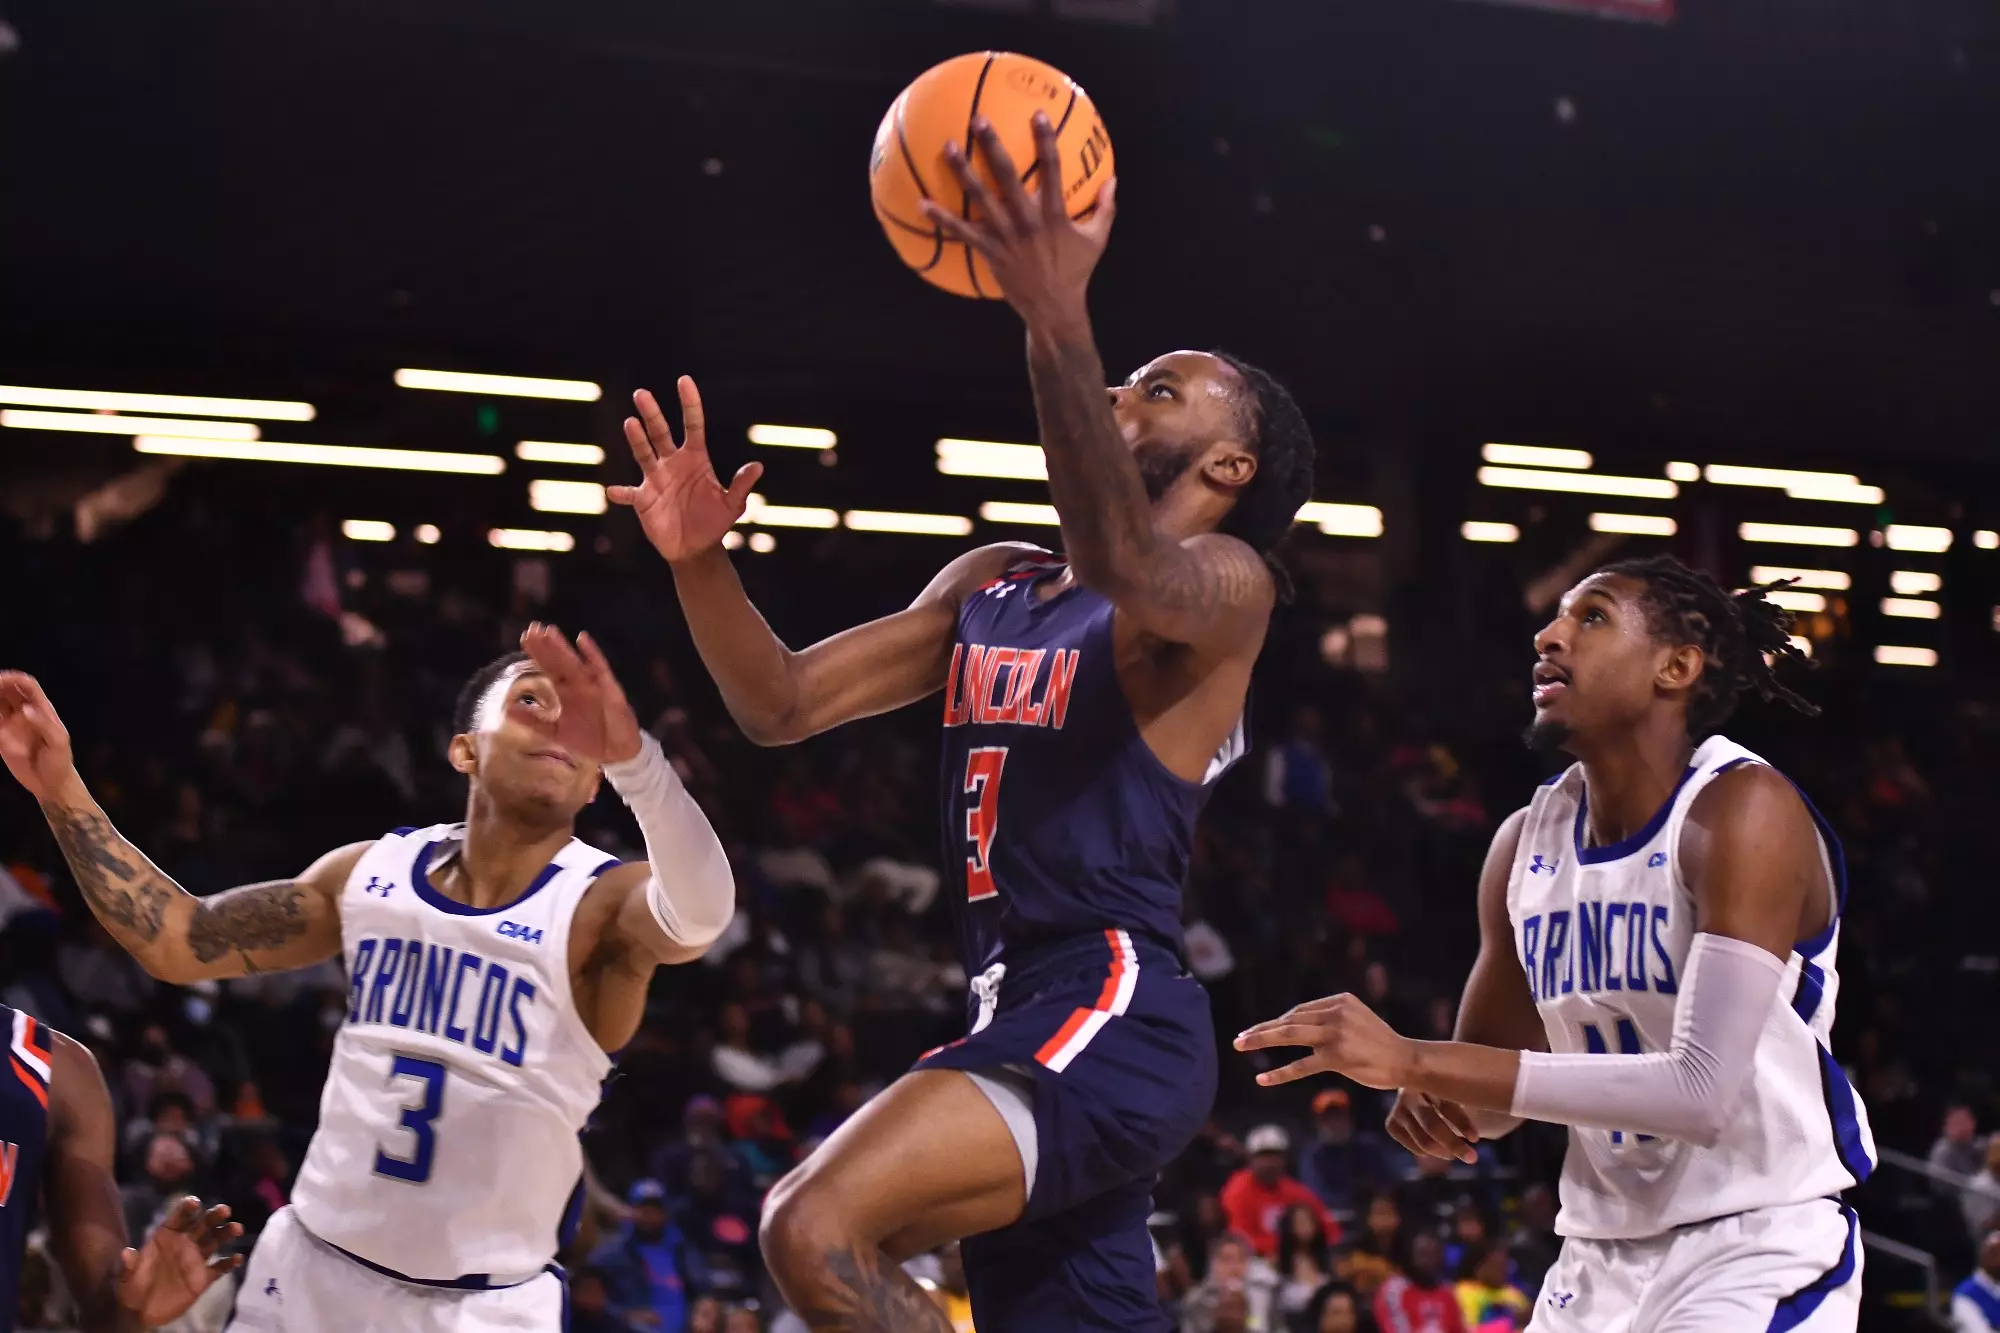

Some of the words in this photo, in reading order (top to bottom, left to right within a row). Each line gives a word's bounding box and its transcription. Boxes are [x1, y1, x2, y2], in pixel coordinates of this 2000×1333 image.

[943, 643, 1080, 730] LINCOLN
[964, 746, 1009, 904] 3
[350, 937, 536, 1067] BRONCOS
[374, 1050, 446, 1184] 3
